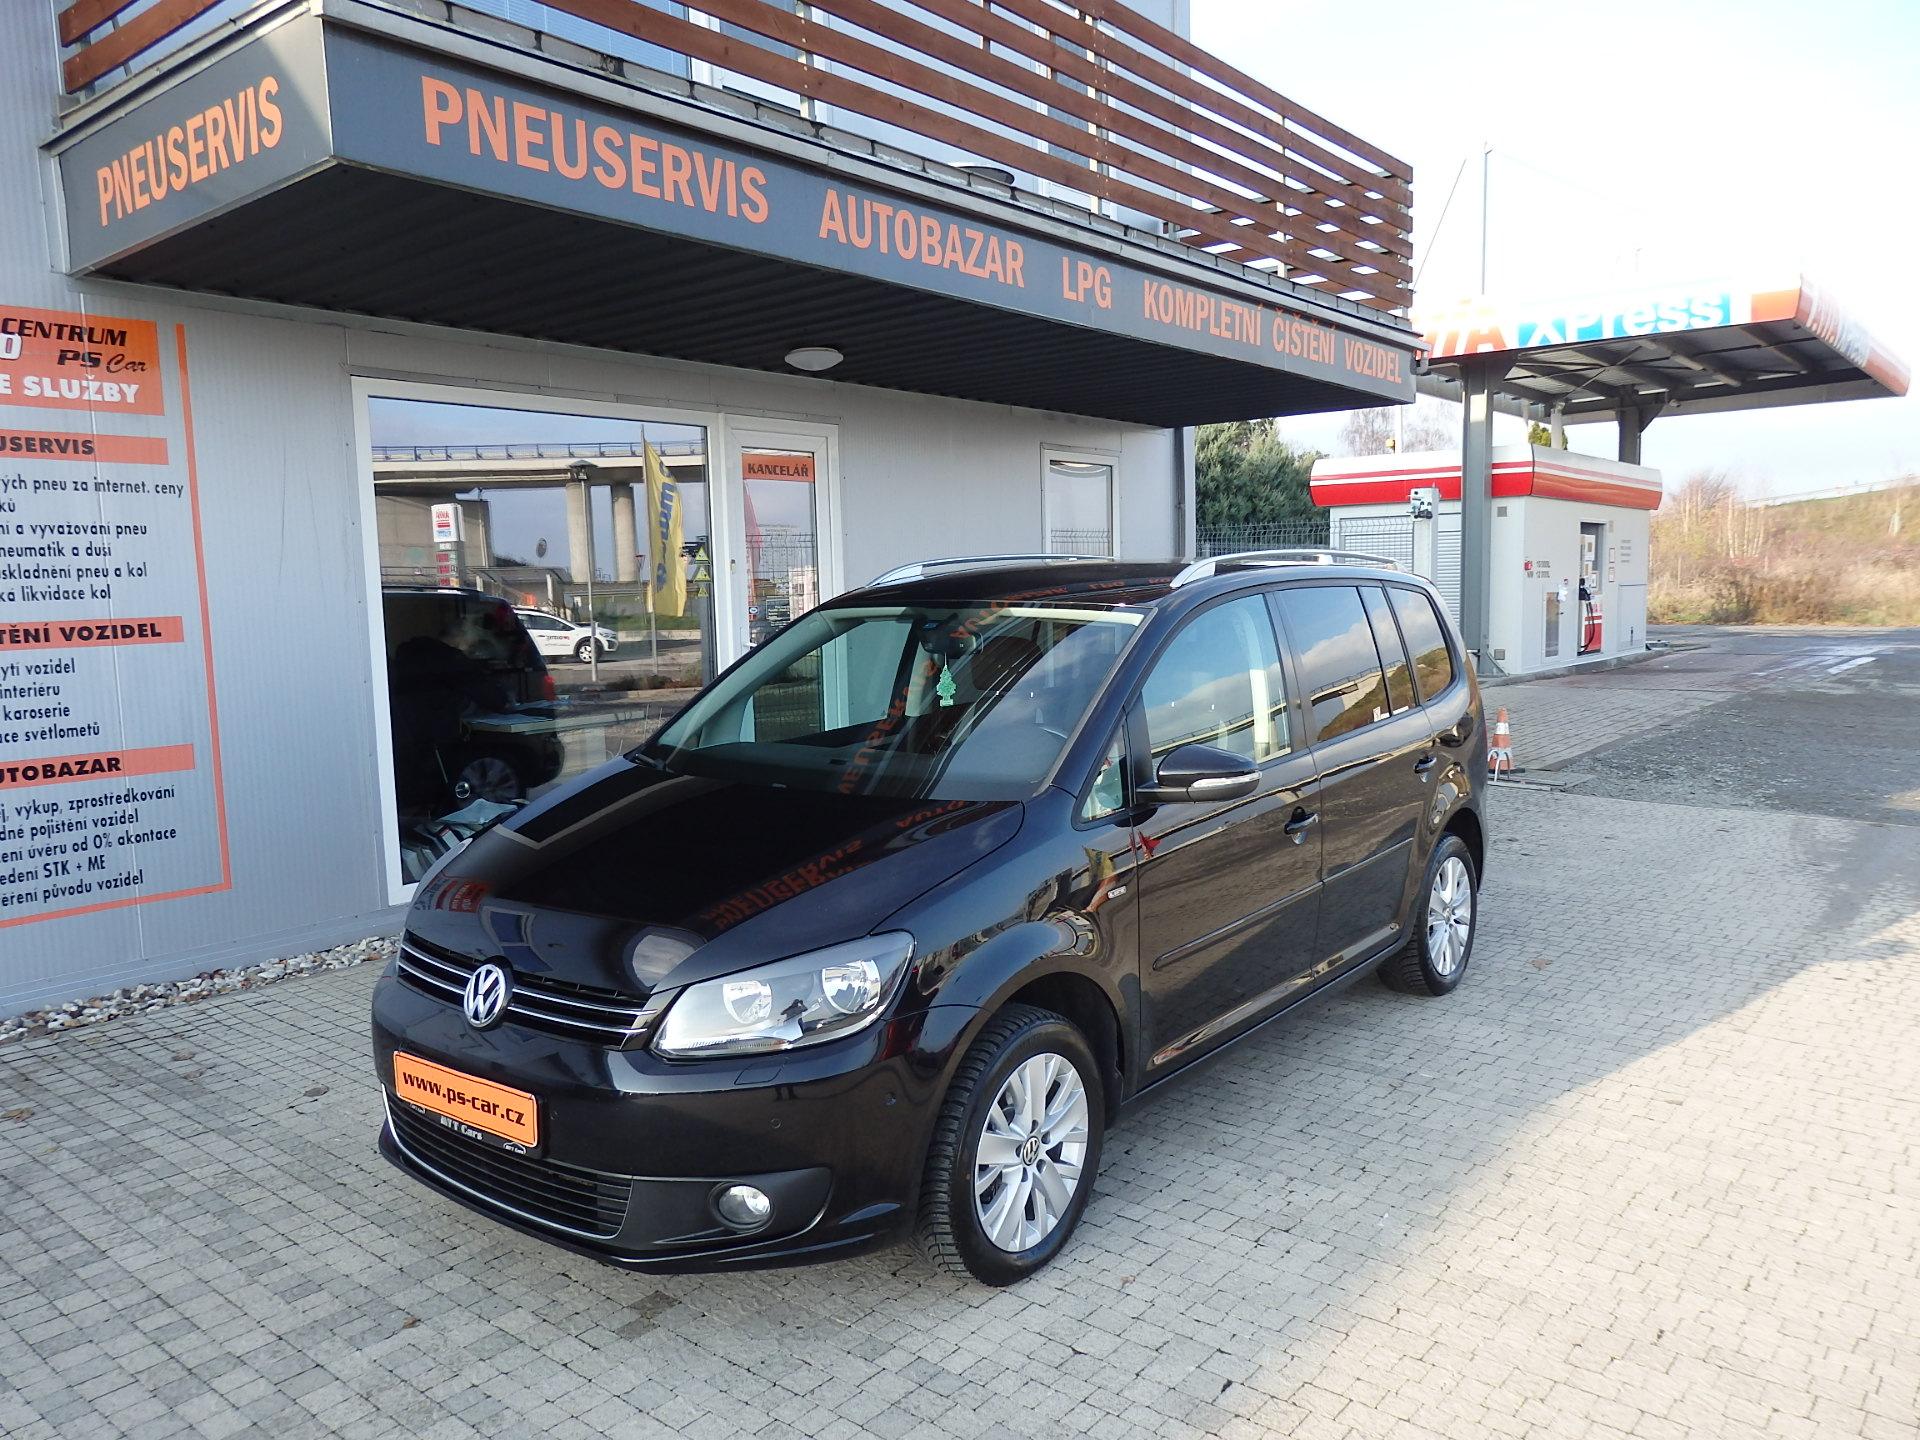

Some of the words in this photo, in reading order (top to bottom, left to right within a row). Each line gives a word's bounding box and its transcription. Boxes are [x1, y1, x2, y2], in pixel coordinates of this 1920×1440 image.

[96, 75, 283, 228] PNEUSERVIS
[421, 75, 769, 224] PNEUSERVIS
[818, 188, 1025, 288] AUTOBAZAR
[1062, 256, 1112, 309] LPG
[1143, 279, 1263, 346] KOMPLETNÍ
[1271, 306, 1336, 366] ČIŠTĚNÍ
[1344, 338, 1402, 384] VOZIDEL
[2, 318, 127, 346] CENTRUM
[57, 349, 103, 368] PS
[106, 353, 148, 374] Car
[23, 374, 140, 403] SLUŽBY
[747, 463, 808, 477] KANCELÁŘ
[34, 479, 67, 494] pneu
[73, 481, 89, 492] za
[94, 476, 150, 494] internet.
[155, 482, 184, 498] ceny
[16, 524, 24, 535] a
[30, 521, 111, 539] vyvažování
[116, 523, 148, 539] pneu
[71, 547, 80, 557] a
[0, 563, 71, 580] skladnění
[77, 567, 109, 582] pneu
[114, 568, 122, 578] a
[127, 562, 148, 578] kol
[22, 585, 85, 601] likvidace
[91, 583, 112, 600] kol
[59, 622, 162, 642] VOZIDEL
[25, 657, 76, 676] vozidel
[3, 702, 70, 721] karoserie
[0, 733, 19, 743] ce
[92, 808, 139, 829] vozidel
[0, 846, 23, 864] ení
[72, 836, 88, 853] od
[93, 832, 112, 849] 0%
[117, 828, 177, 846] akontace
[43, 860, 70, 879] STK
[88, 855, 106, 872] ME
[97, 869, 144, 891] vozidel
[403, 1072, 526, 1127] www.ps-car.cz
